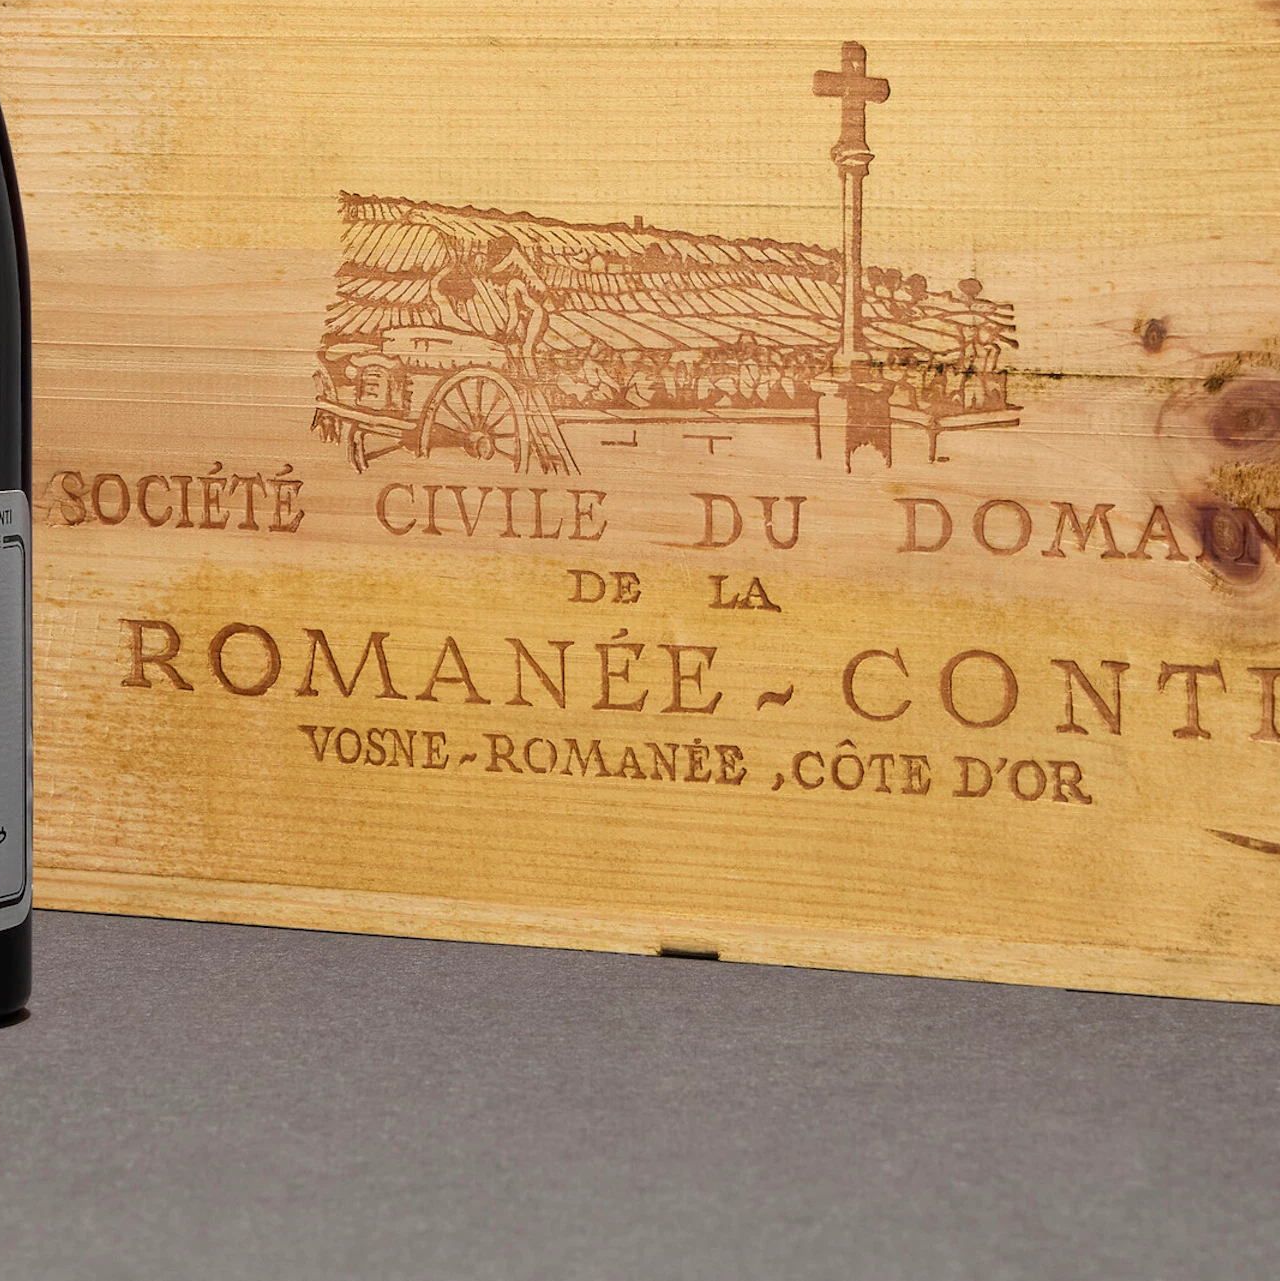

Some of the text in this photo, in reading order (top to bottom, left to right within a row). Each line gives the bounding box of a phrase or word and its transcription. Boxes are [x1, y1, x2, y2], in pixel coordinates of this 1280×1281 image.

[45, 462, 305, 533] SOCIÉTÉ
[374, 483, 608, 540] CIVILE
[691, 492, 807, 550] DU
[567, 569, 782, 612] DE LA
[299, 725, 747, 785] VOSNE-ROMANÉE
